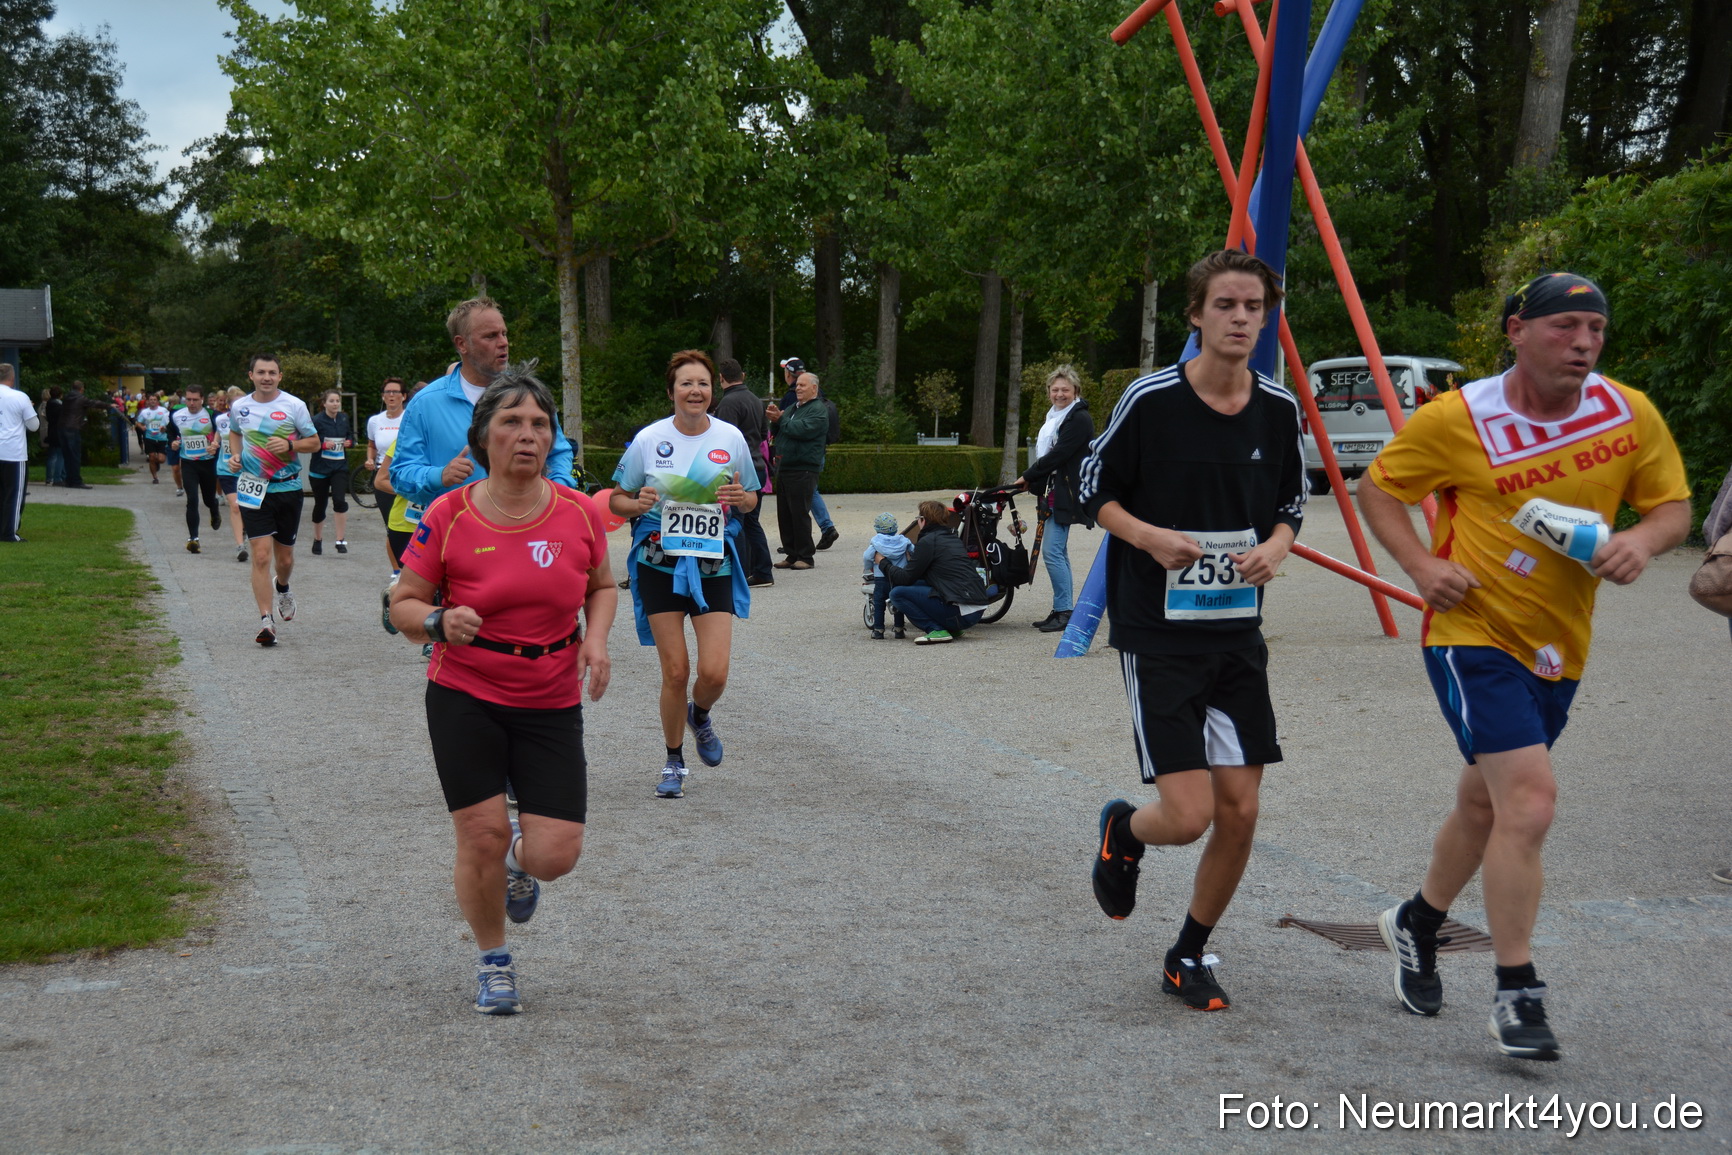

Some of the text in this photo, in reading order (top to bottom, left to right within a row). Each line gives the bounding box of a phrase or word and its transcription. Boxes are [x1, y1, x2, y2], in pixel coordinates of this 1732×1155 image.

[1331, 371, 1374, 386] SEE-CA
[185, 440, 205, 450] 3091
[711, 452, 729, 461] Hervis
[1494, 433, 1639, 496] MAX BÖGL
[668, 513, 720, 537] 2068
[1533, 520, 1567, 546] 2
[681, 539, 703, 549] Karin
[1205, 539, 1248, 550] Neumarkt
[1194, 593, 1232, 608] Martin
